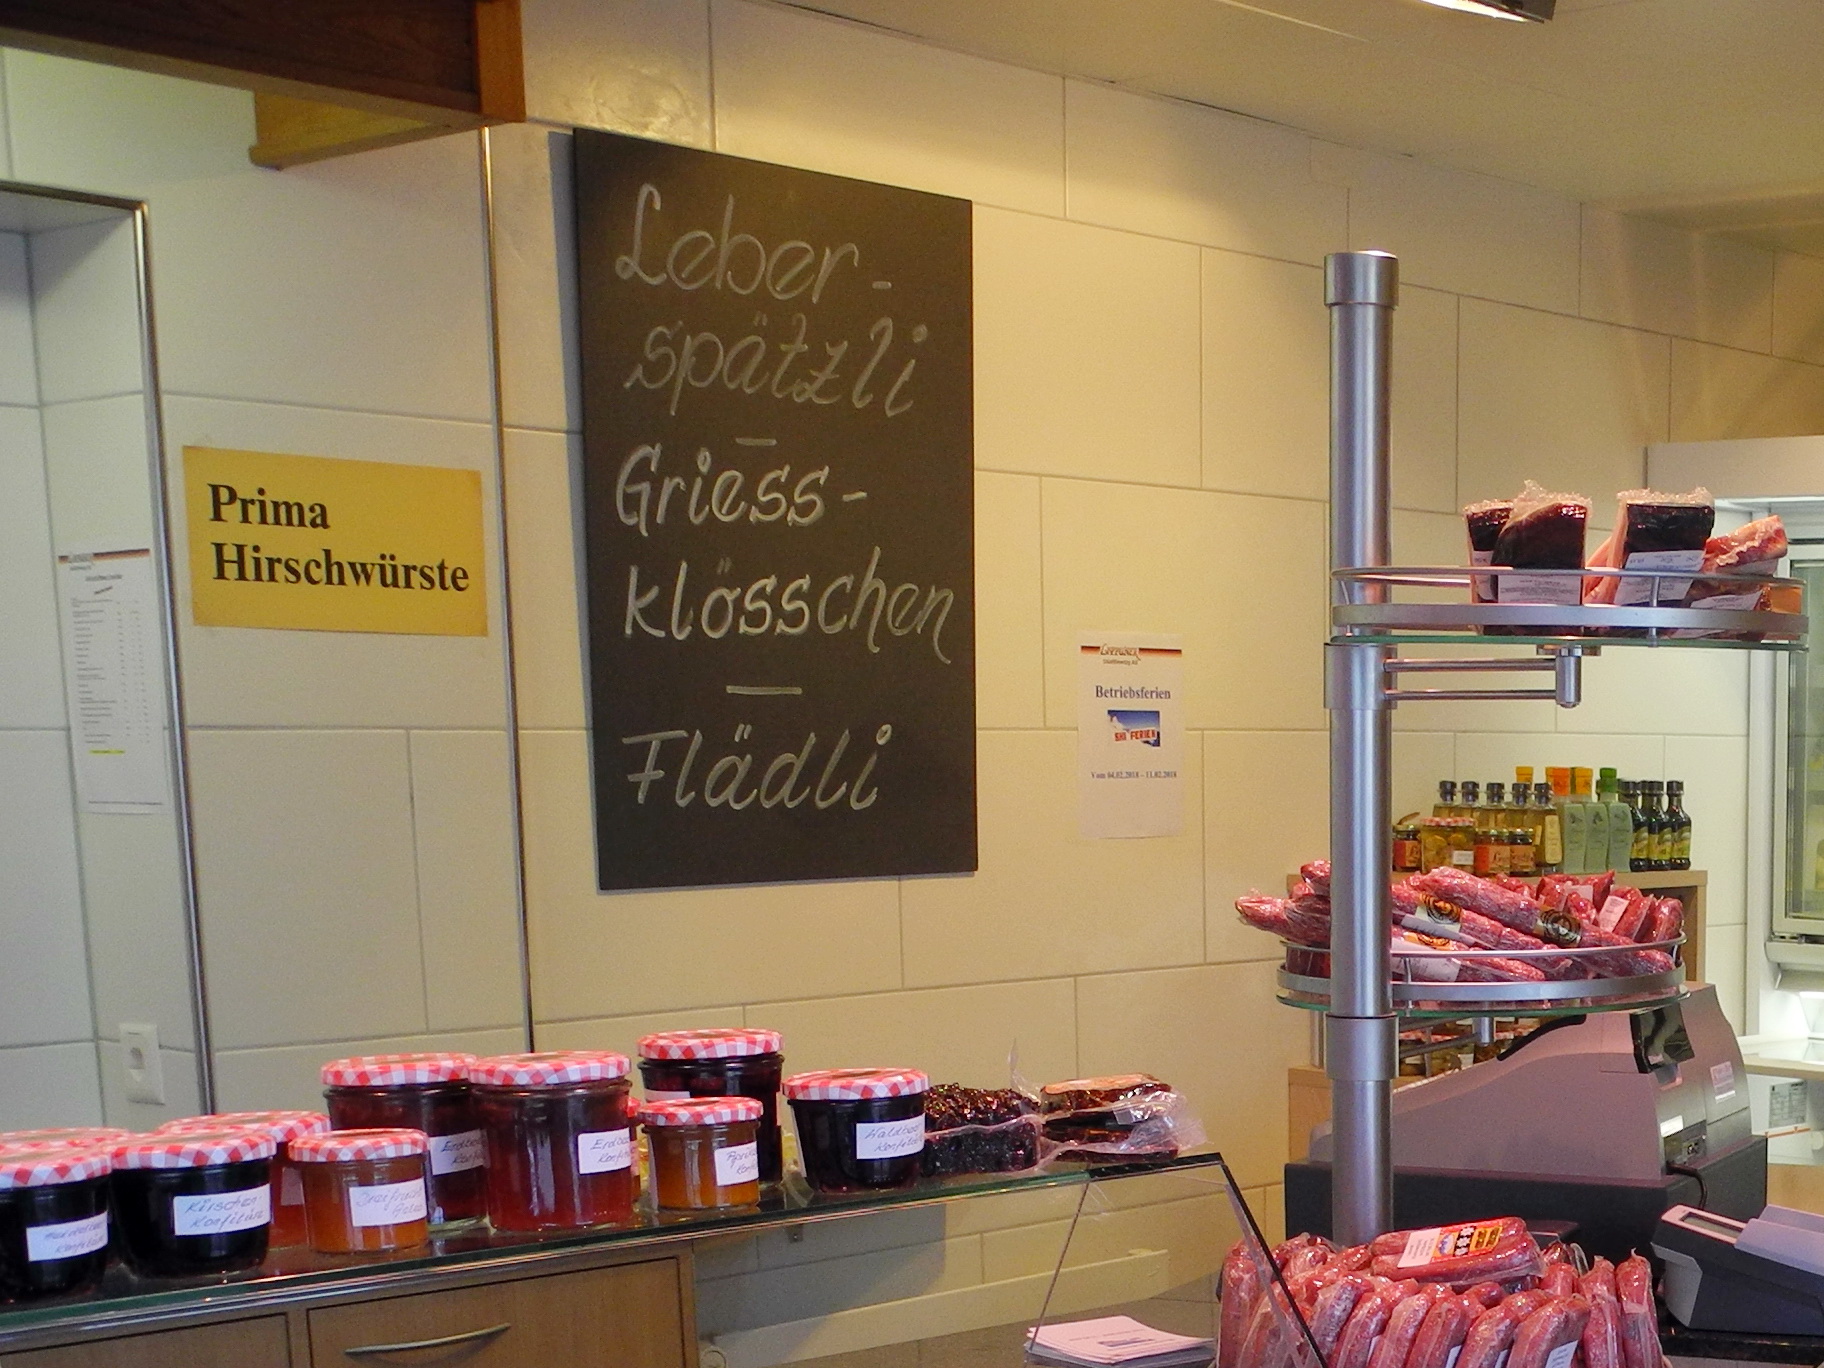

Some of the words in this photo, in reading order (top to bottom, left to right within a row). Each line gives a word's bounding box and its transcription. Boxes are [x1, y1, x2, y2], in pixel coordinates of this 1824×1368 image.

[623, 313, 929, 417] spätzli
[207, 483, 331, 530] Prima
[616, 443, 867, 537] Griess-
[211, 541, 470, 592] Hirschwürste
[1095, 685, 1171, 699] Betriebsferien
[622, 724, 893, 810] Flädli
